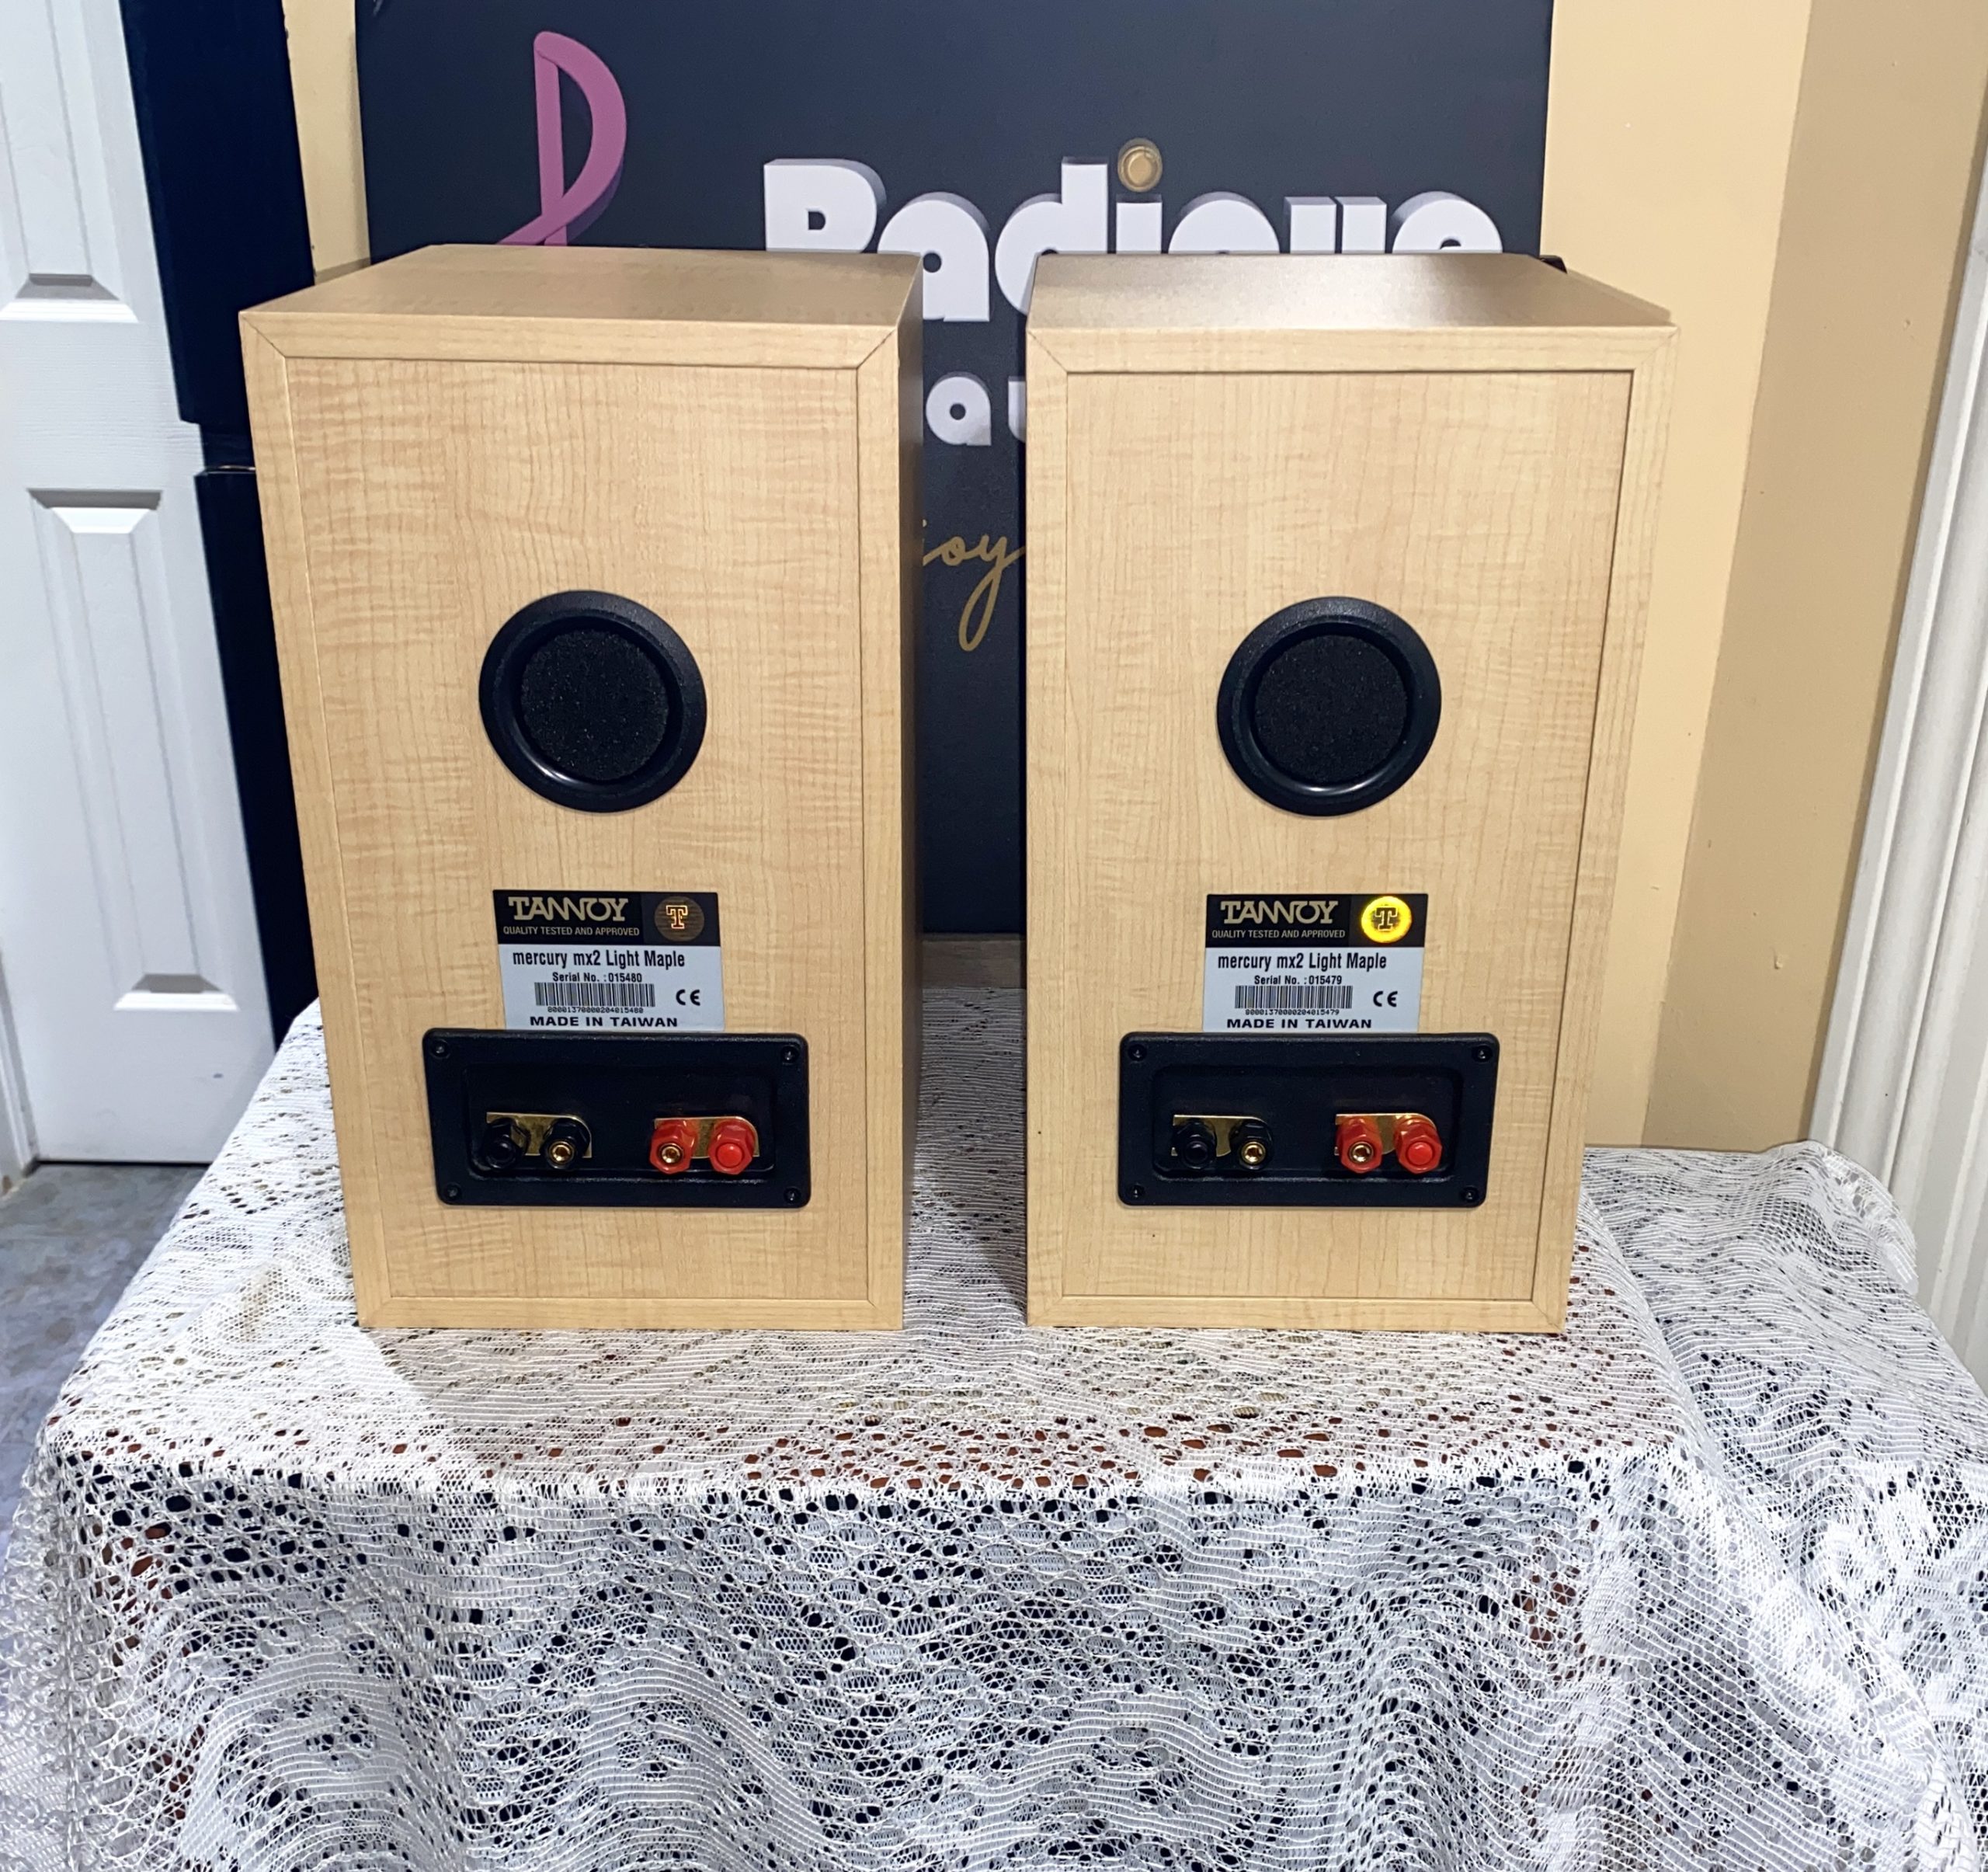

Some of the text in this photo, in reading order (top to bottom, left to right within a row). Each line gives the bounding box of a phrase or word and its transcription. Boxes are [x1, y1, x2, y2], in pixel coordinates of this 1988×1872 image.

[508, 896, 629, 922] TANNOY
[1220, 900, 1339, 924] TANNOY
[503, 926, 640, 936] QUALITY TESTED AND APPROVED
[1211, 929, 1346, 938] QUALITY TESTED AND APPROVED
[513, 949, 685, 970] mercury mx2 Light Maple
[1218, 952, 1387, 972] mercury mx2 Light Maple
[552, 972, 580, 982] Serial
[584, 973, 600, 982] No.
[1254, 975, 1281, 984] Serial
[1284, 976, 1300, 984] No.
[530, 1016, 678, 1027] MADE IN TAIWAN
[1227, 1018, 1372, 1028] MADE IN TAIWAN
